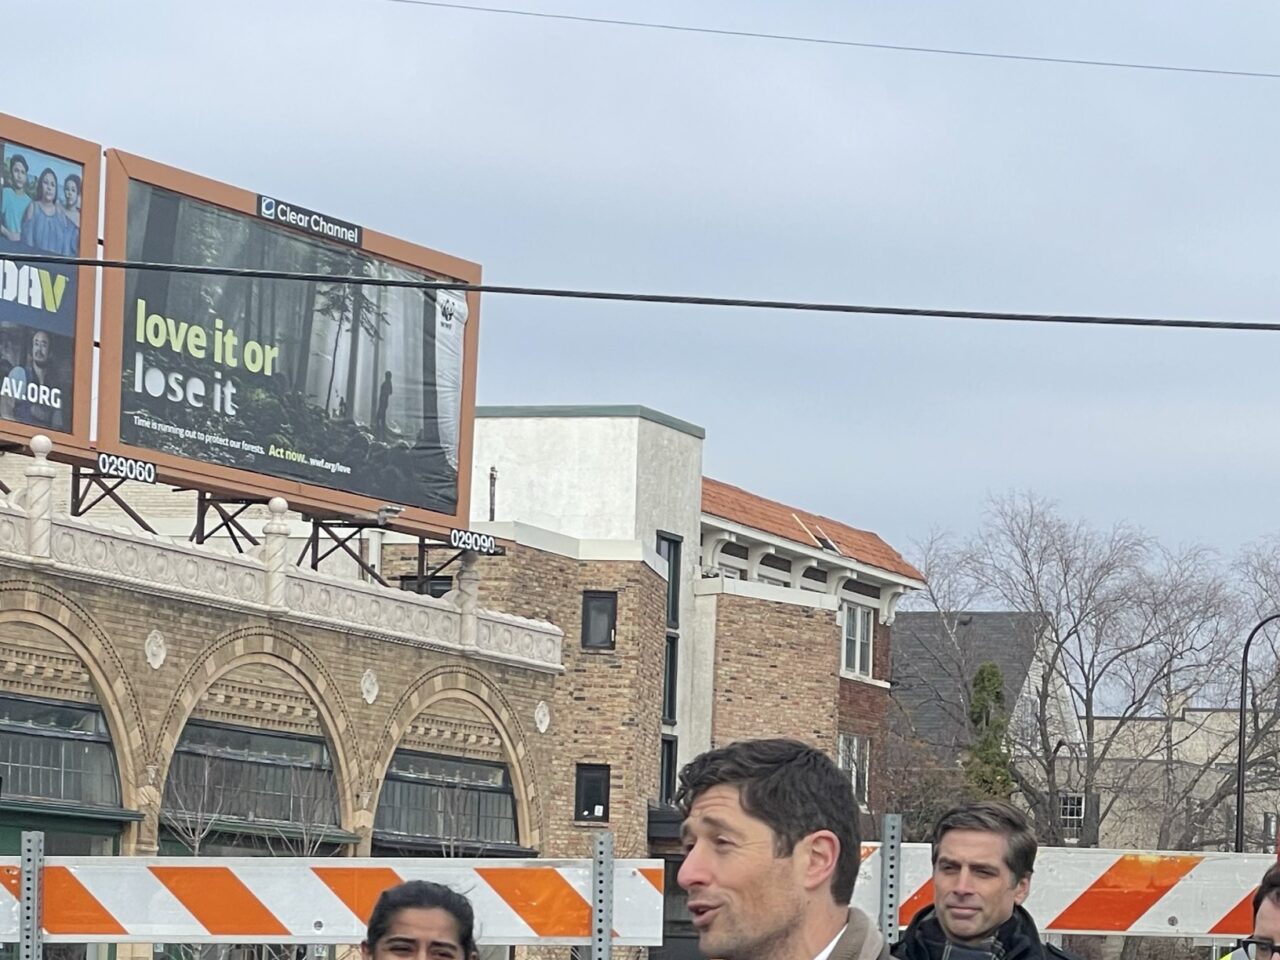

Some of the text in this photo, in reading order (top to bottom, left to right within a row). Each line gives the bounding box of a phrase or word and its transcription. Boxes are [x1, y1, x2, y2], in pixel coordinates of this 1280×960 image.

[277, 204, 358, 243] Clear Channel
[136, 298, 279, 376] love it or
[134, 351, 238, 416] lose it
[133, 415, 266, 455] Time is running out to protect our forests.
[268, 444, 284, 459] Act
[99, 453, 155, 483] 029060
[451, 529, 495, 554] 029090
